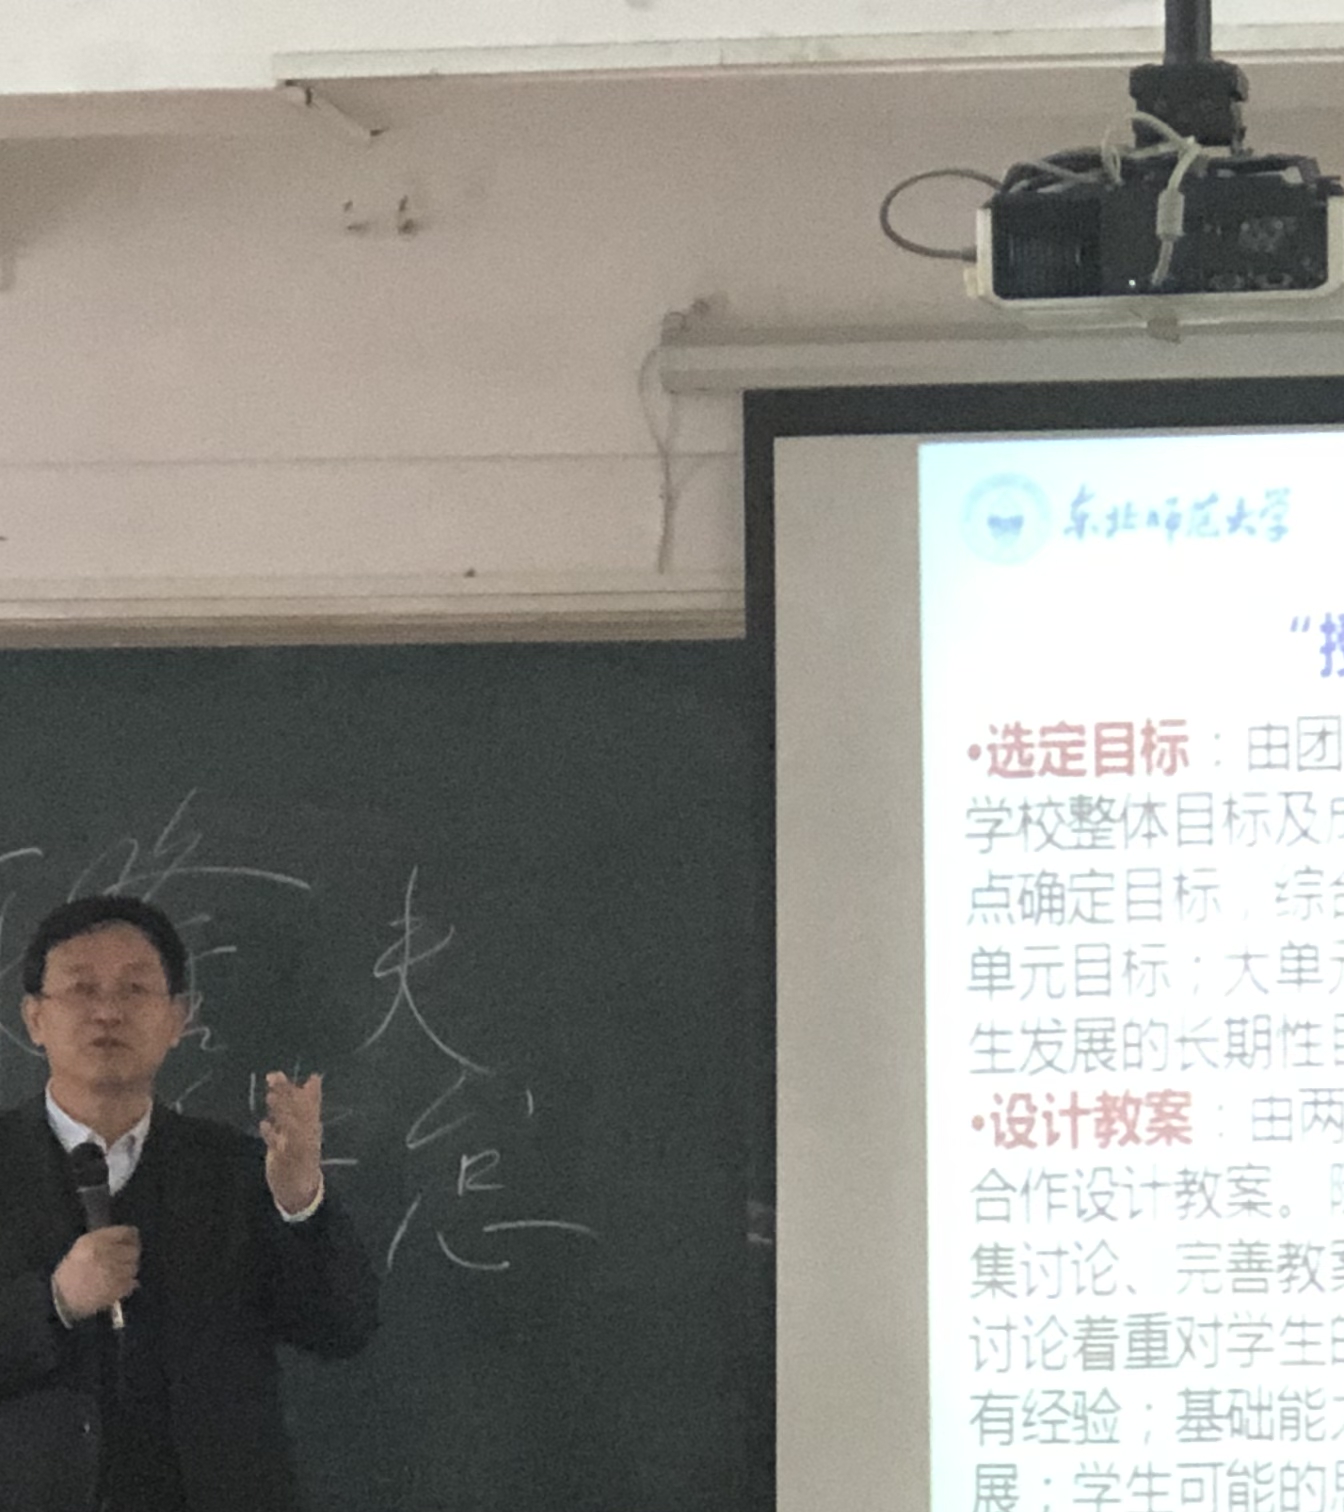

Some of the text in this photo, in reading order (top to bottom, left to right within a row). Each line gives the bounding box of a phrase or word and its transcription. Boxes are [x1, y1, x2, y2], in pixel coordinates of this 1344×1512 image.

[1062, 485, 1292, 544] 东北师范大学
